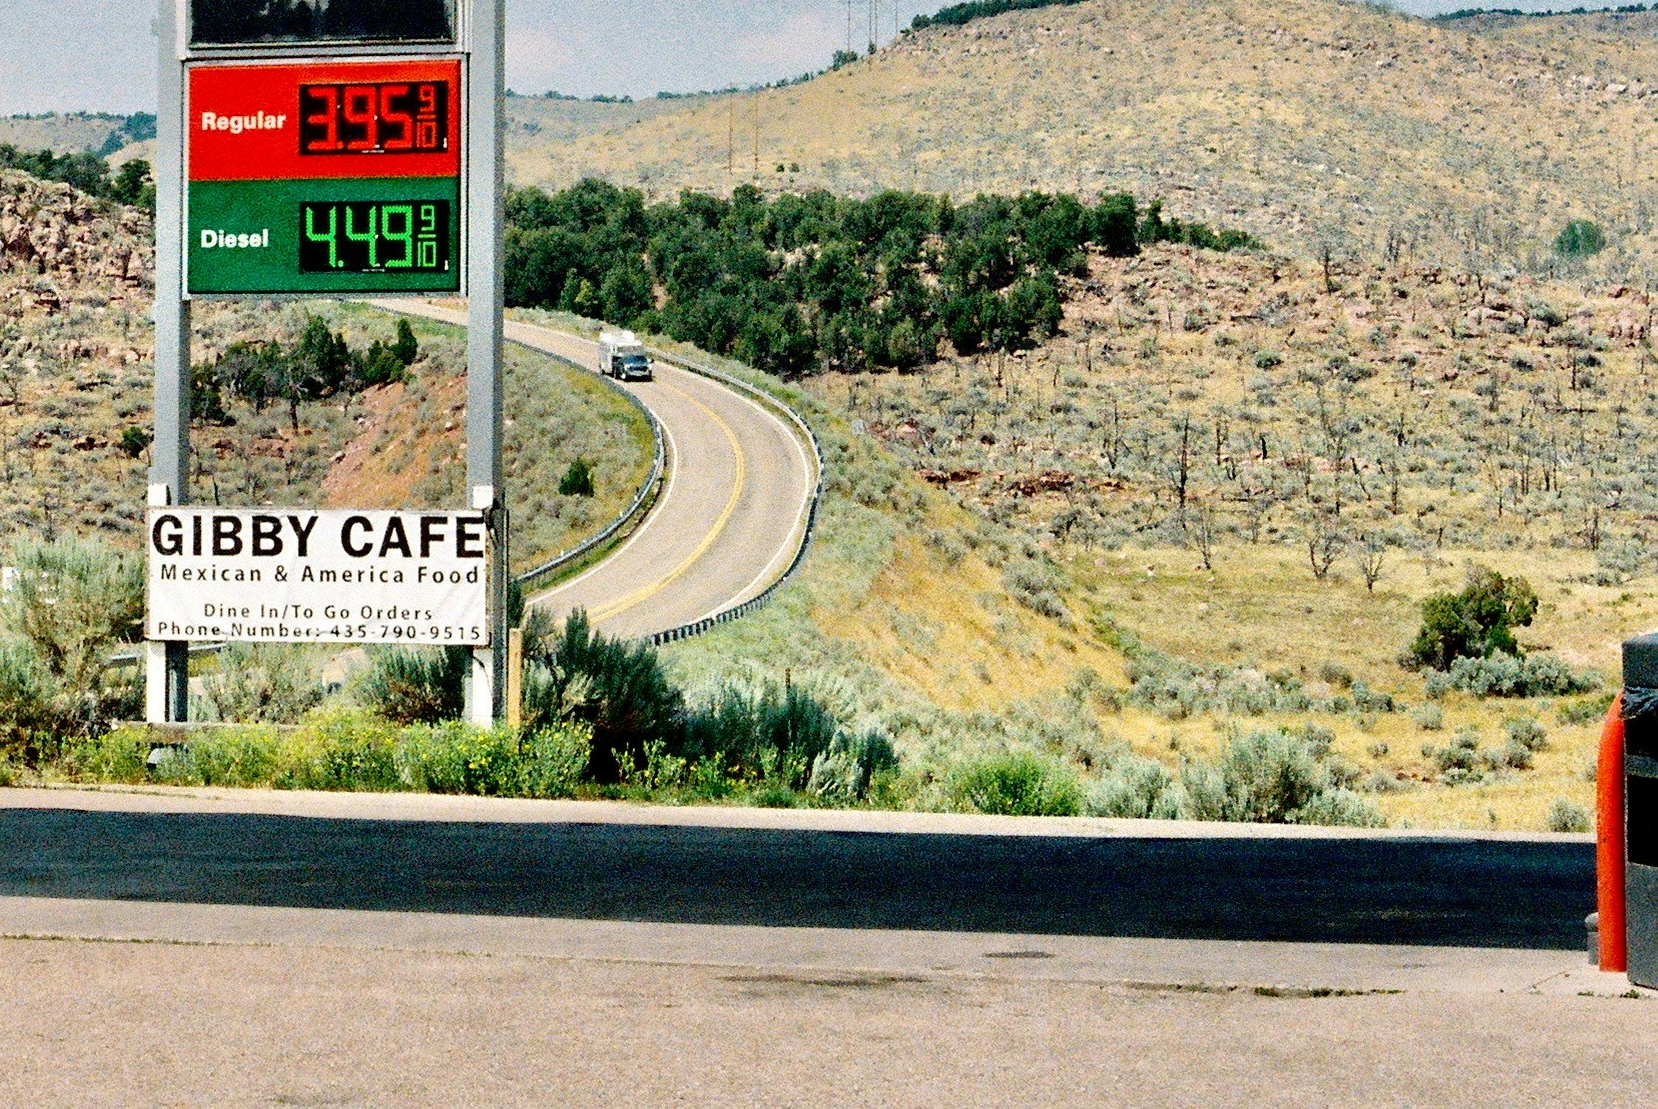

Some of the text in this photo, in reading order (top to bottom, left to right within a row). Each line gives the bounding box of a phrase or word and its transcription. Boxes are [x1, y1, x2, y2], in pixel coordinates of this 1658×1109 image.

[201, 110, 287, 134] Regular
[307, 85, 413, 150] 3.95
[200, 228, 269, 248] Diesel
[305, 205, 413, 268] 4.49
[151, 514, 485, 559] GIBBY CAFE
[160, 564, 479, 584] Mexican & America Food
[203, 603, 433, 621] Dine In/To Go Orders
[158, 622, 221, 636] Phone
[329, 624, 481, 640] 435-790-9515
